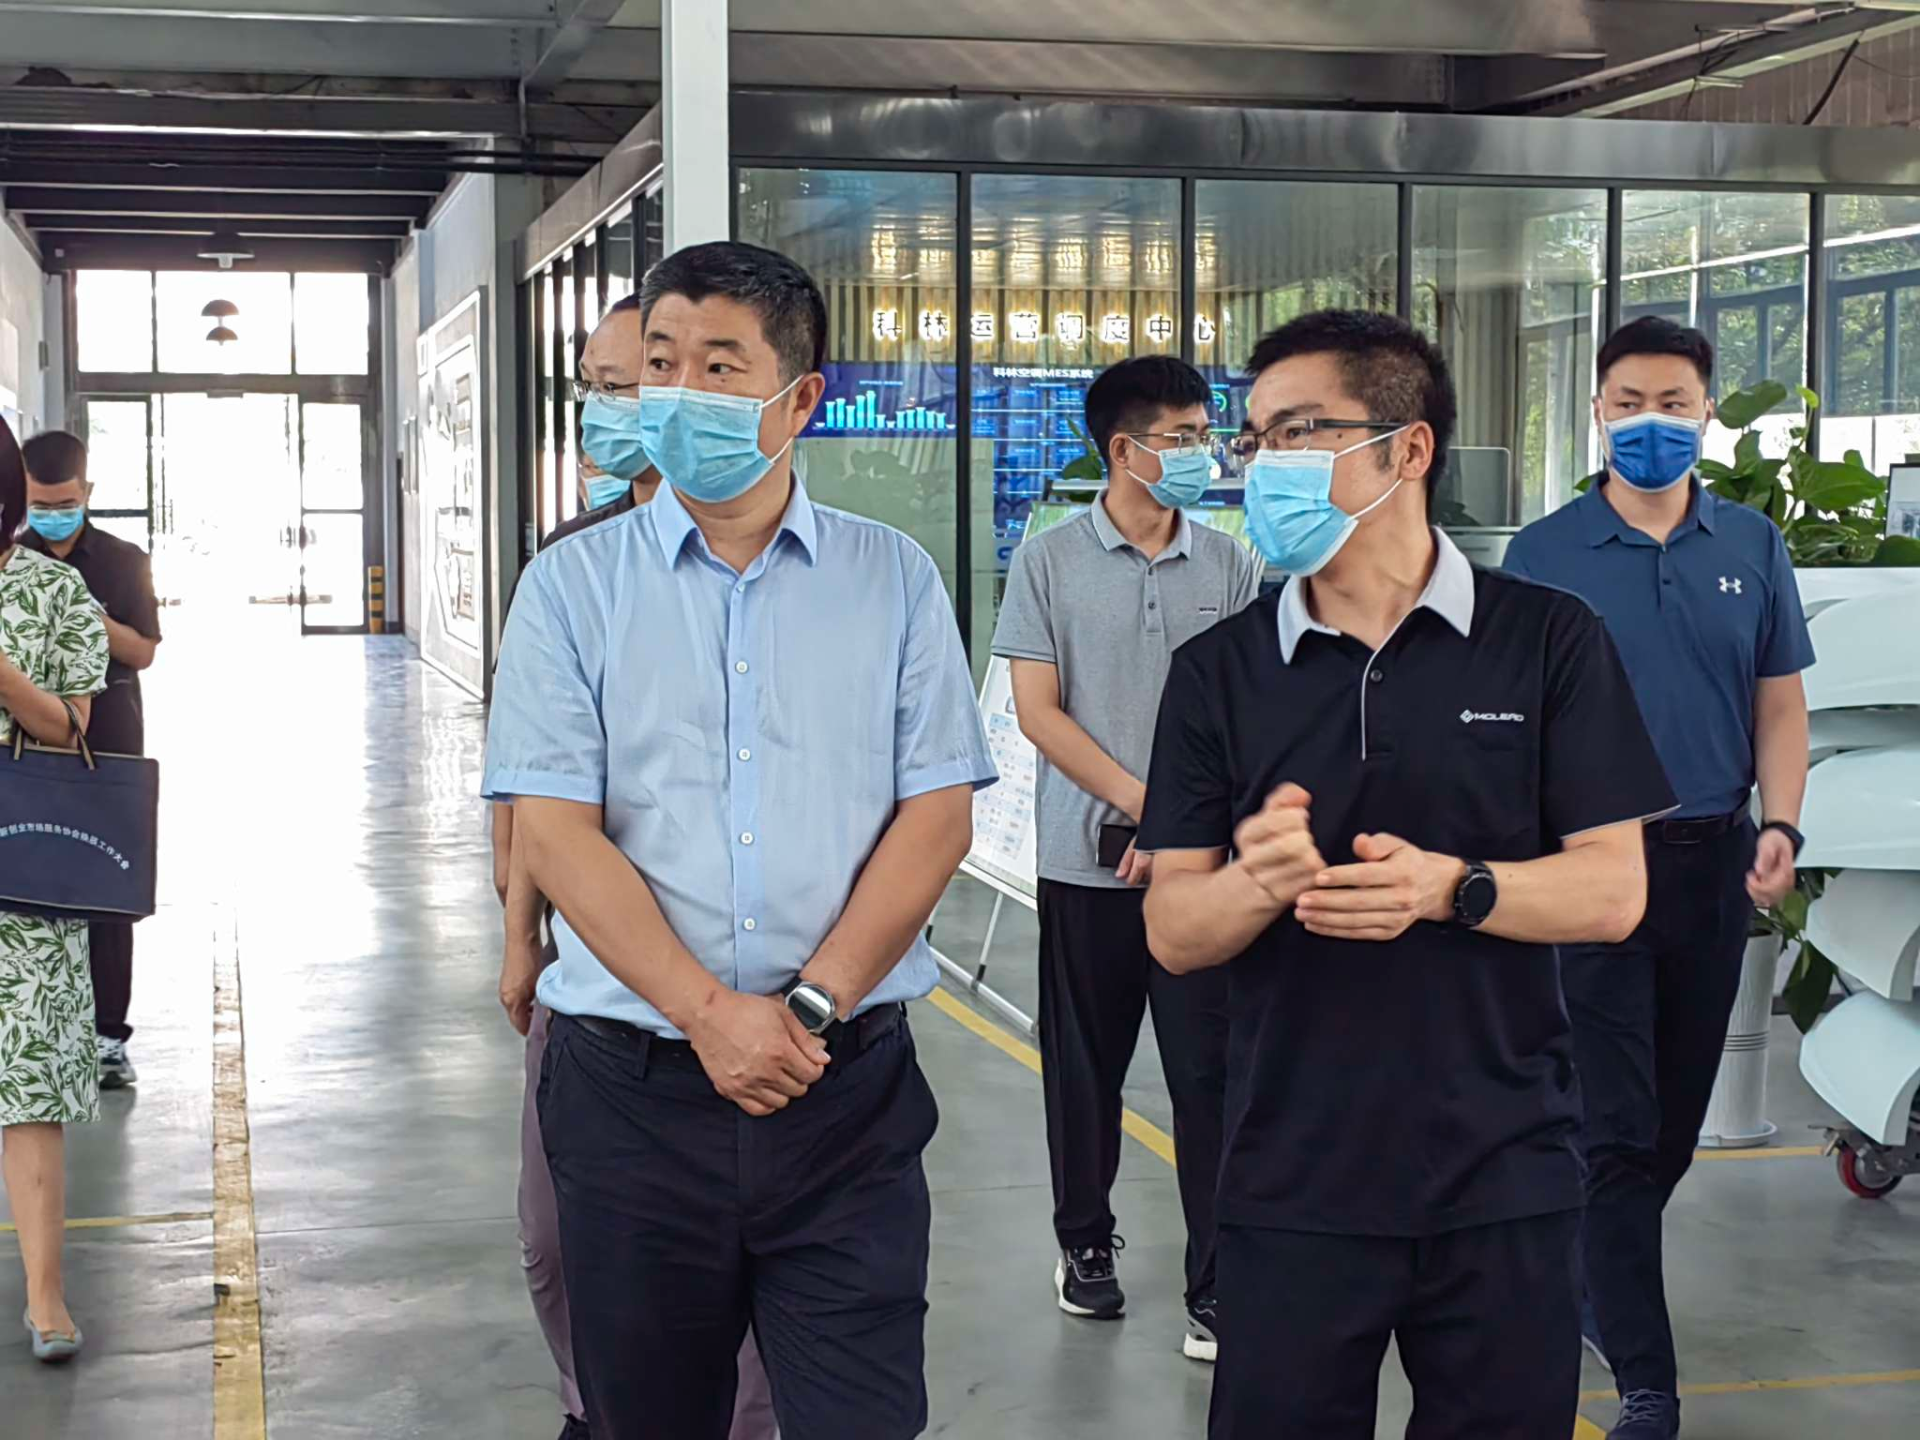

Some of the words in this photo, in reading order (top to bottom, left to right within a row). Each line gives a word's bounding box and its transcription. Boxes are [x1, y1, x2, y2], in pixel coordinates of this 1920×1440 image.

[875, 311, 1216, 342] 科林运营调度中心
